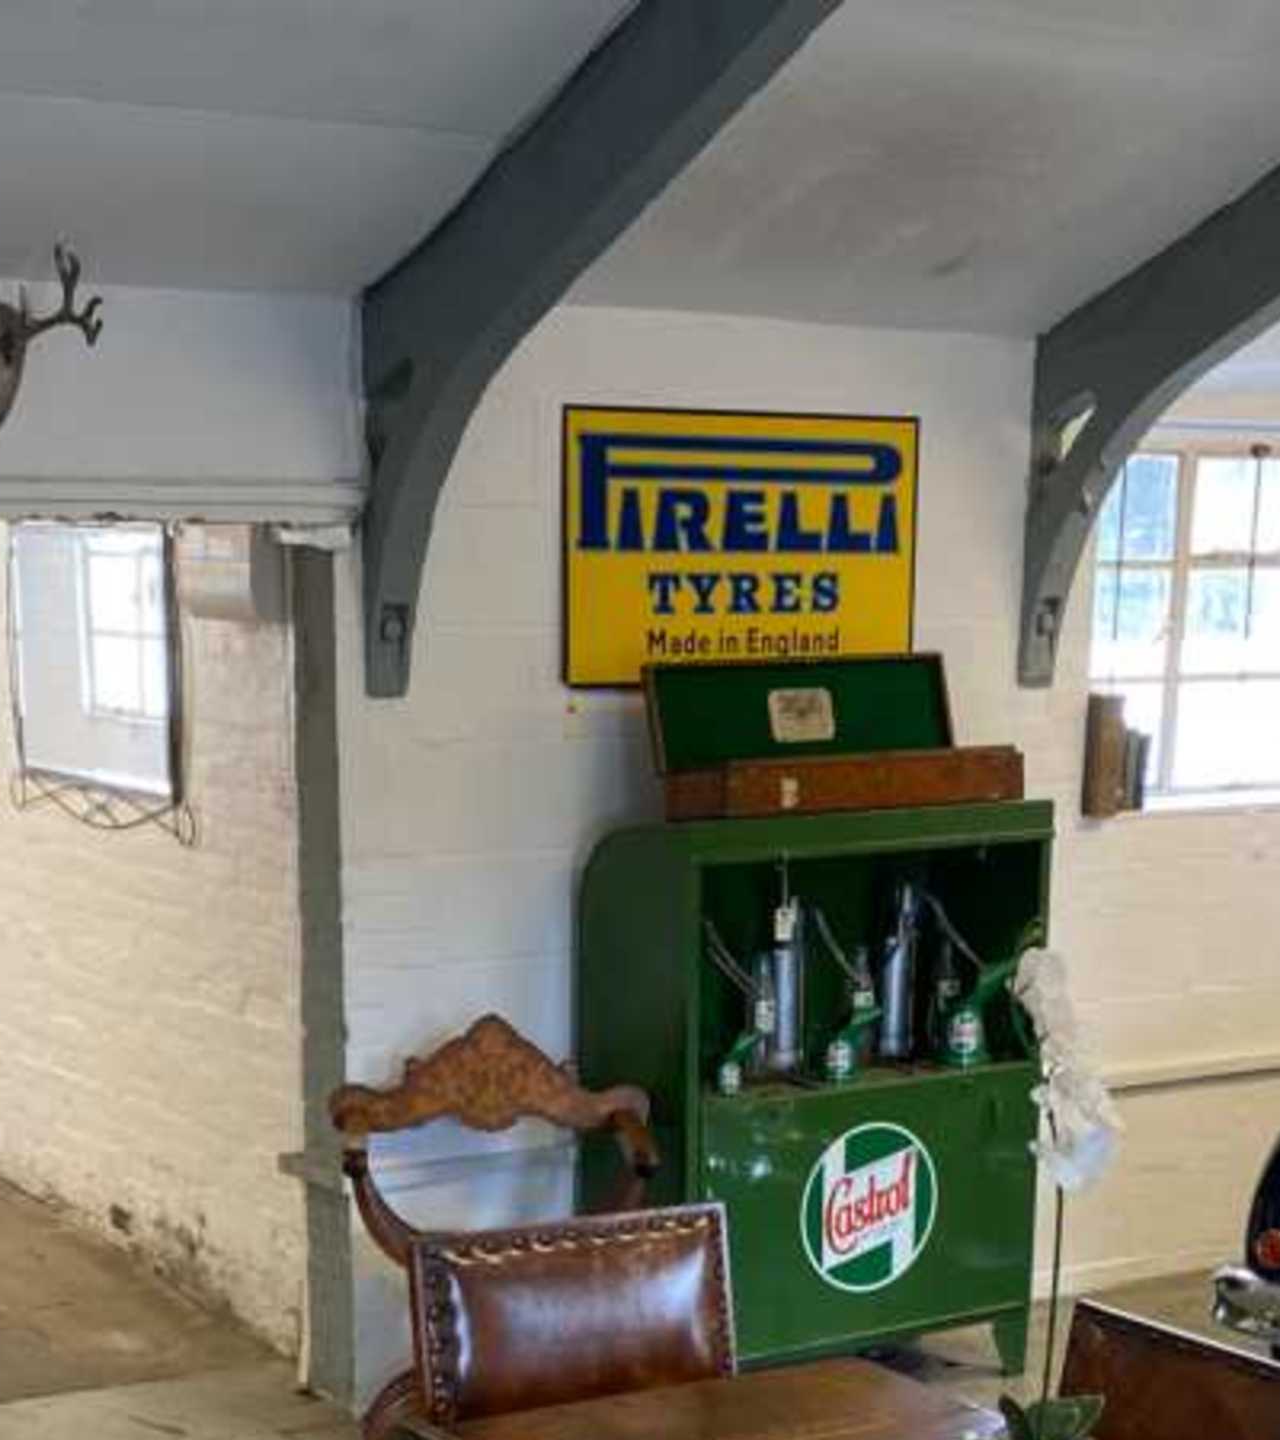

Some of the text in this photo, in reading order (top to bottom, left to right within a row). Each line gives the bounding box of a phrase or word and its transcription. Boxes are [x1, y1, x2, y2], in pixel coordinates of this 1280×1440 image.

[576, 433, 903, 552] PIRELLI
[647, 572, 841, 614] TYRES
[647, 627, 840, 656] Made in England
[825, 1151, 911, 1255] Castrol
